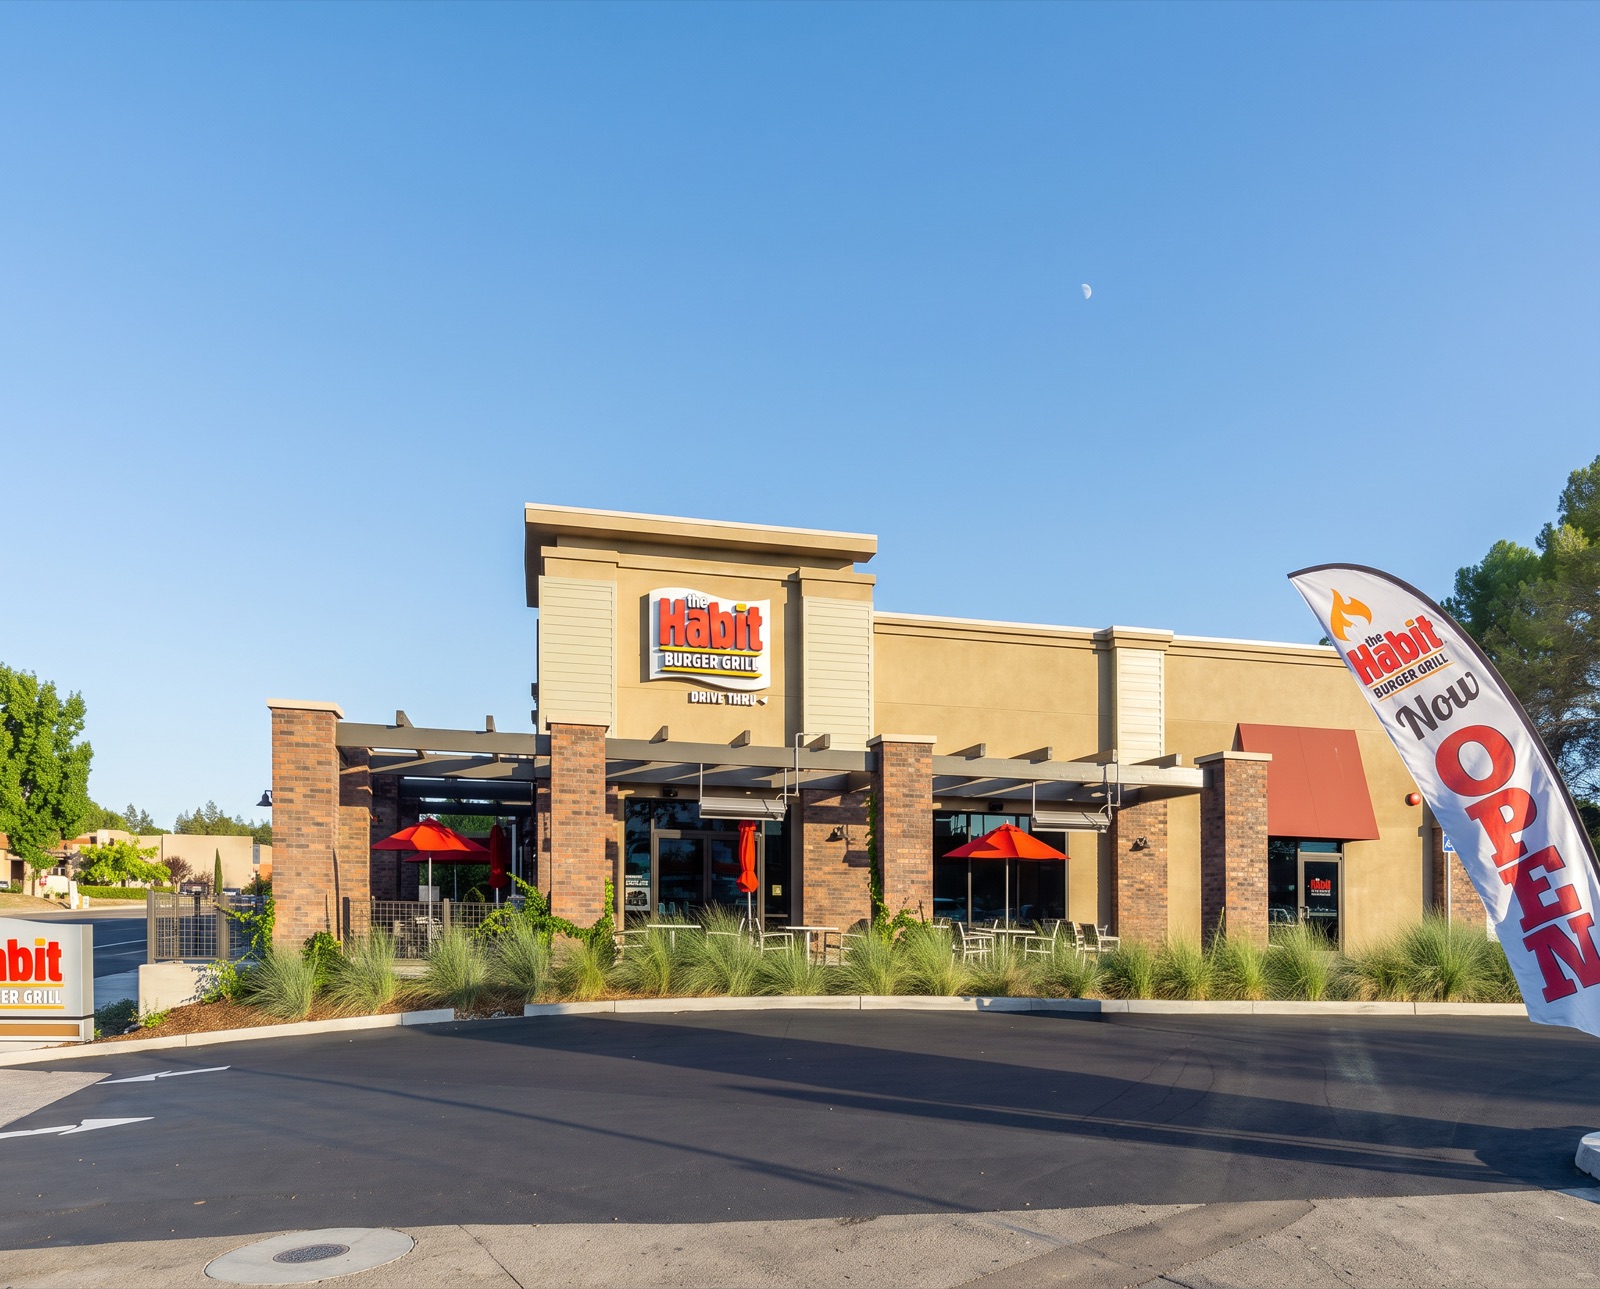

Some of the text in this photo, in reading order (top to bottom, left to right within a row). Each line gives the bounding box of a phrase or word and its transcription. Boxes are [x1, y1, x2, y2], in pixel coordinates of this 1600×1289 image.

[687, 594, 707, 609] the
[659, 598, 763, 651] Habit
[1365, 633, 1384, 648] the
[665, 652, 759, 671] BURGER GRILL
[1346, 615, 1444, 686] Habit
[690, 690, 757, 706] DRIVE THRU
[1373, 653, 1449, 699] BURGER GRILL
[1395, 671, 1480, 741] Now
[1435, 724, 1600, 1003] OPEN
[0, 938, 63, 982] bit
[23, 990, 62, 1004] GRILL
